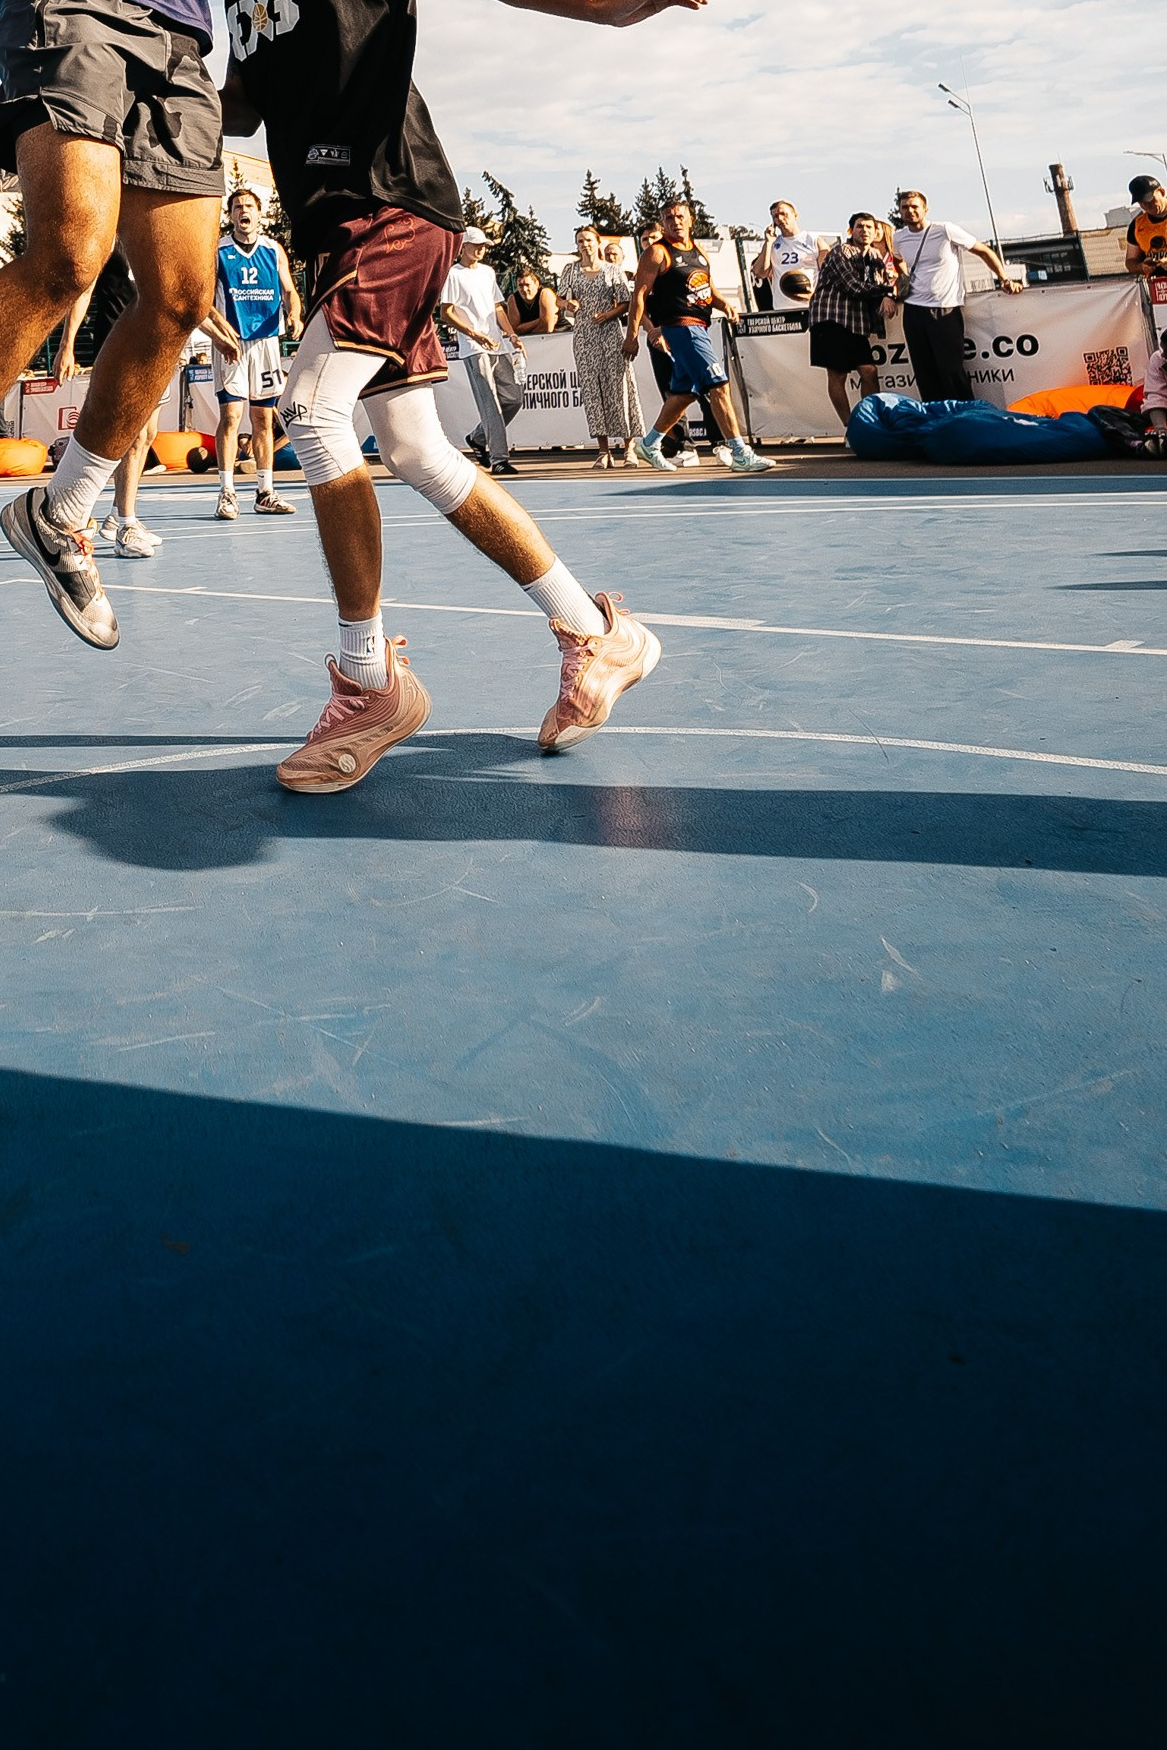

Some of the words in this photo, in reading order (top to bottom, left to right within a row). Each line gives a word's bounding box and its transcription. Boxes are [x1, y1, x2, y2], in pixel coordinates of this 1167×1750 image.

[780, 252, 799, 266] 23
[240, 266, 258, 285] 12
[260, 369, 282, 389] 51
[523, 368, 567, 391] ЕРСКОЙ
[522, 390, 569, 410] ЛИЧНОГО
